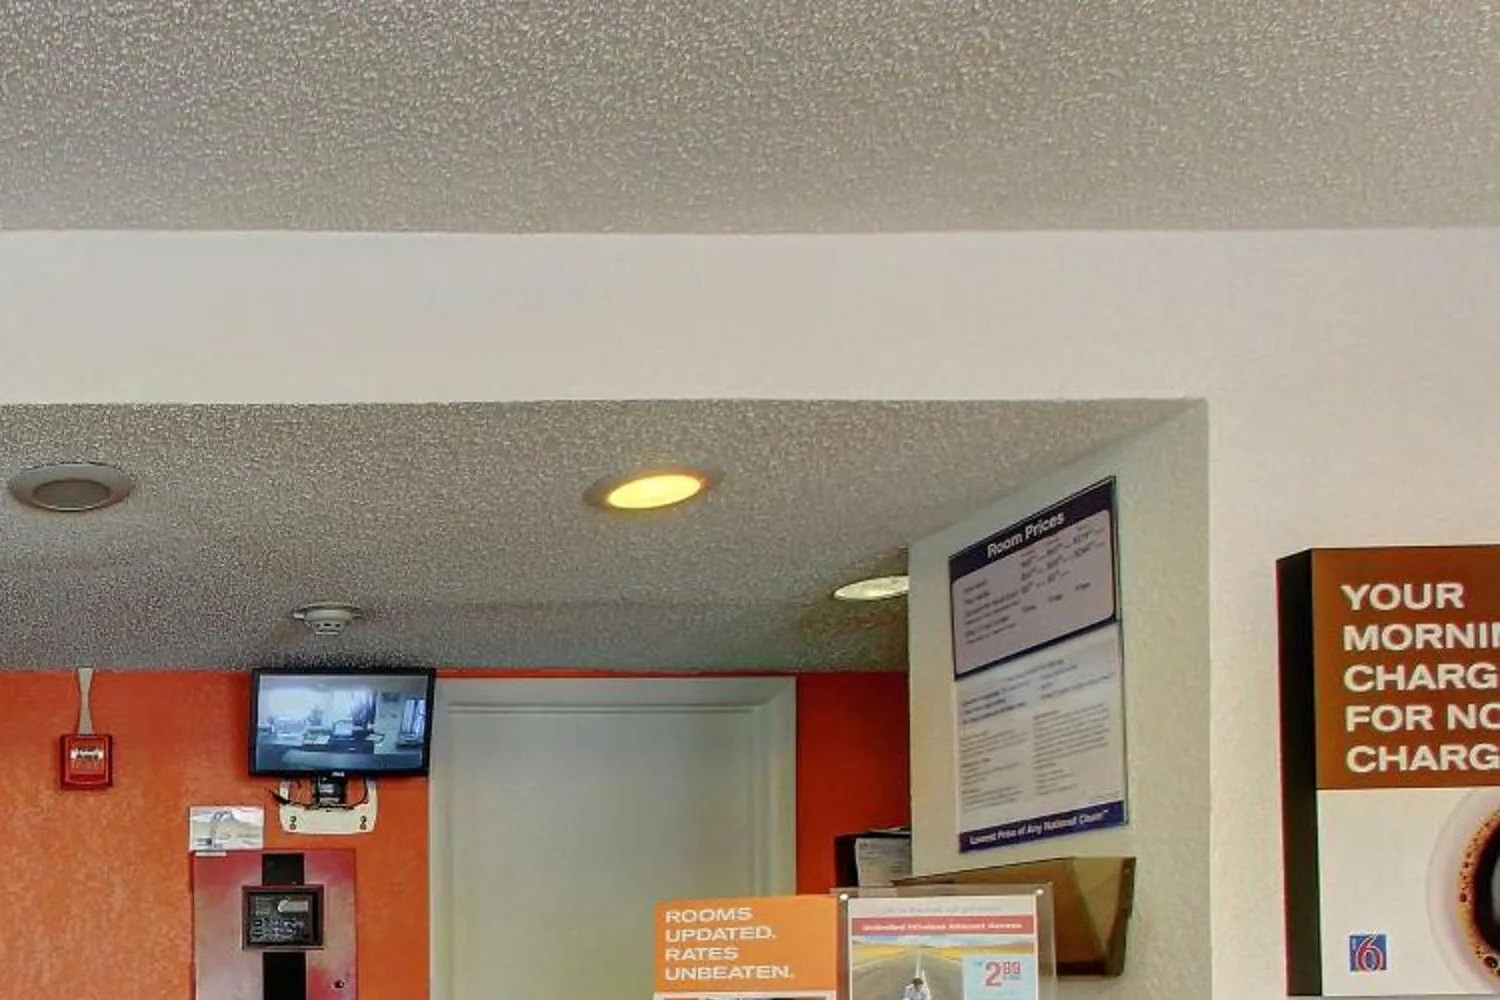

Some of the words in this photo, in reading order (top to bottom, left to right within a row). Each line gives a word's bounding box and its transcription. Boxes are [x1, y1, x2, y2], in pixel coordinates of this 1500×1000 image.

[986, 533, 1023, 559] Room
[1025, 512, 1065, 541] Prices
[1341, 582, 1464, 611] YOUR
[1345, 704, 1434, 732] FOR
[665, 907, 753, 923] ROOMS
[665, 925, 778, 943] UPDATED.
[665, 947, 739, 961] RATES
[665, 964, 796, 981] UNBEATEN.
